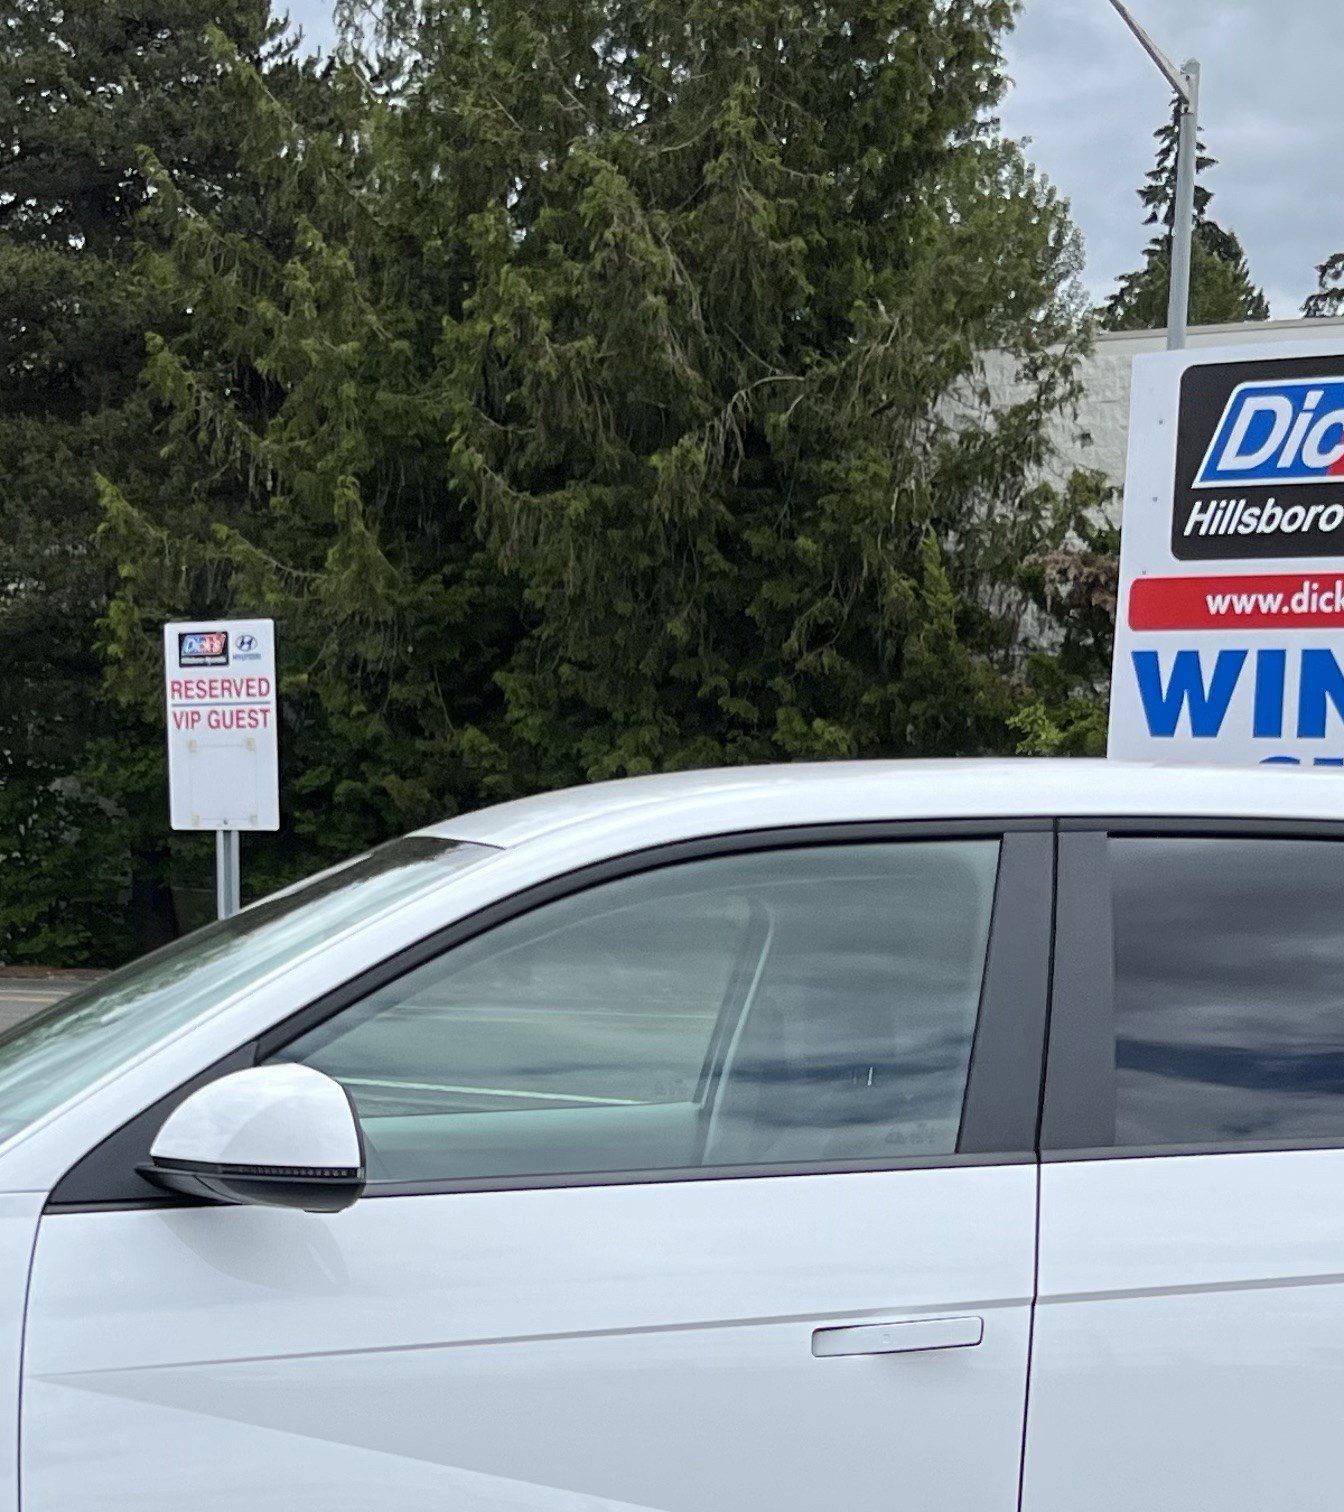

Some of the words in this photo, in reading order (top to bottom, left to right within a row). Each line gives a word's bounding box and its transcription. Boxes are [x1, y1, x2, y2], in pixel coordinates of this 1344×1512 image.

[170, 677, 270, 700] RESERVED
[172, 710, 201, 730] VIP
[208, 709, 270, 730] GUEST
